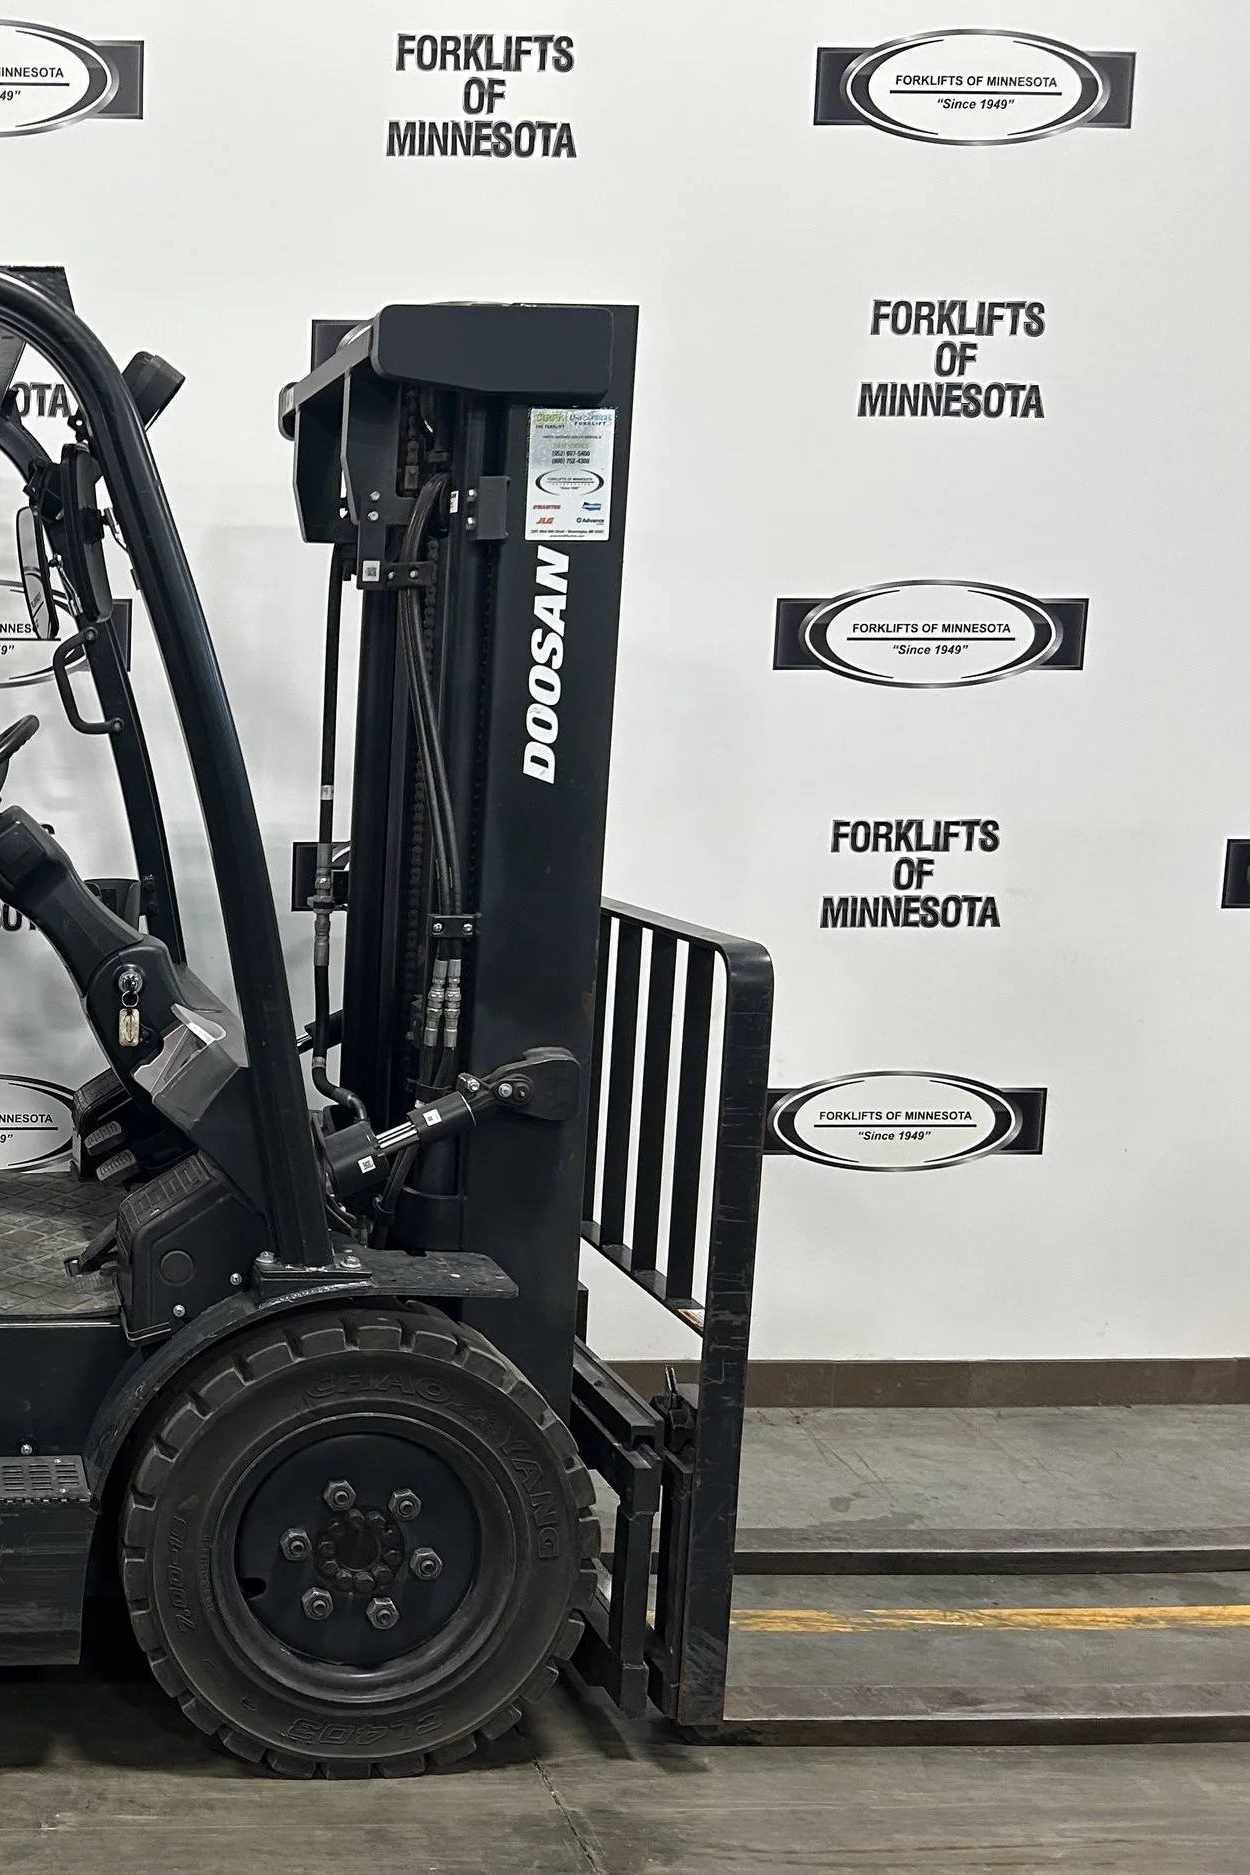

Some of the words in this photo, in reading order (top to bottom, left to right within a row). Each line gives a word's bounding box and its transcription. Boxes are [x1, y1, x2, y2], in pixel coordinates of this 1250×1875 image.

[396, 34, 574, 72] FORKLIFTS
[463, 77, 506, 114] OF
[895, 74, 964, 86] FORKLIFTS
[966, 75, 984, 86] OF
[986, 76, 1058, 88] MINNESOTA
[386, 120, 577, 158] MINNESOTA
[871, 300, 1045, 337] FORKLIFTS
[935, 341, 978, 377] OF
[858, 382, 1044, 418] MINNESOTA
[536, 516, 554, 525] JLG
[852, 623, 919, 634] FORKLIFTS
[921, 623, 939, 634] OF
[941, 623, 1011, 634] MINNESOTA
[523, 545, 570, 784] DOOSAN
[831, 819, 999, 852] FORKLIFTS
[893, 857, 934, 890] OF
[820, 895, 1000, 928] MINNESOTA
[819, 1111, 883, 1121] FORKLIFTS
[885, 1110, 902, 1121] OF
[904, 1110, 973, 1121] MINNESOTA
[495, 1428, 561, 1561] YANG
